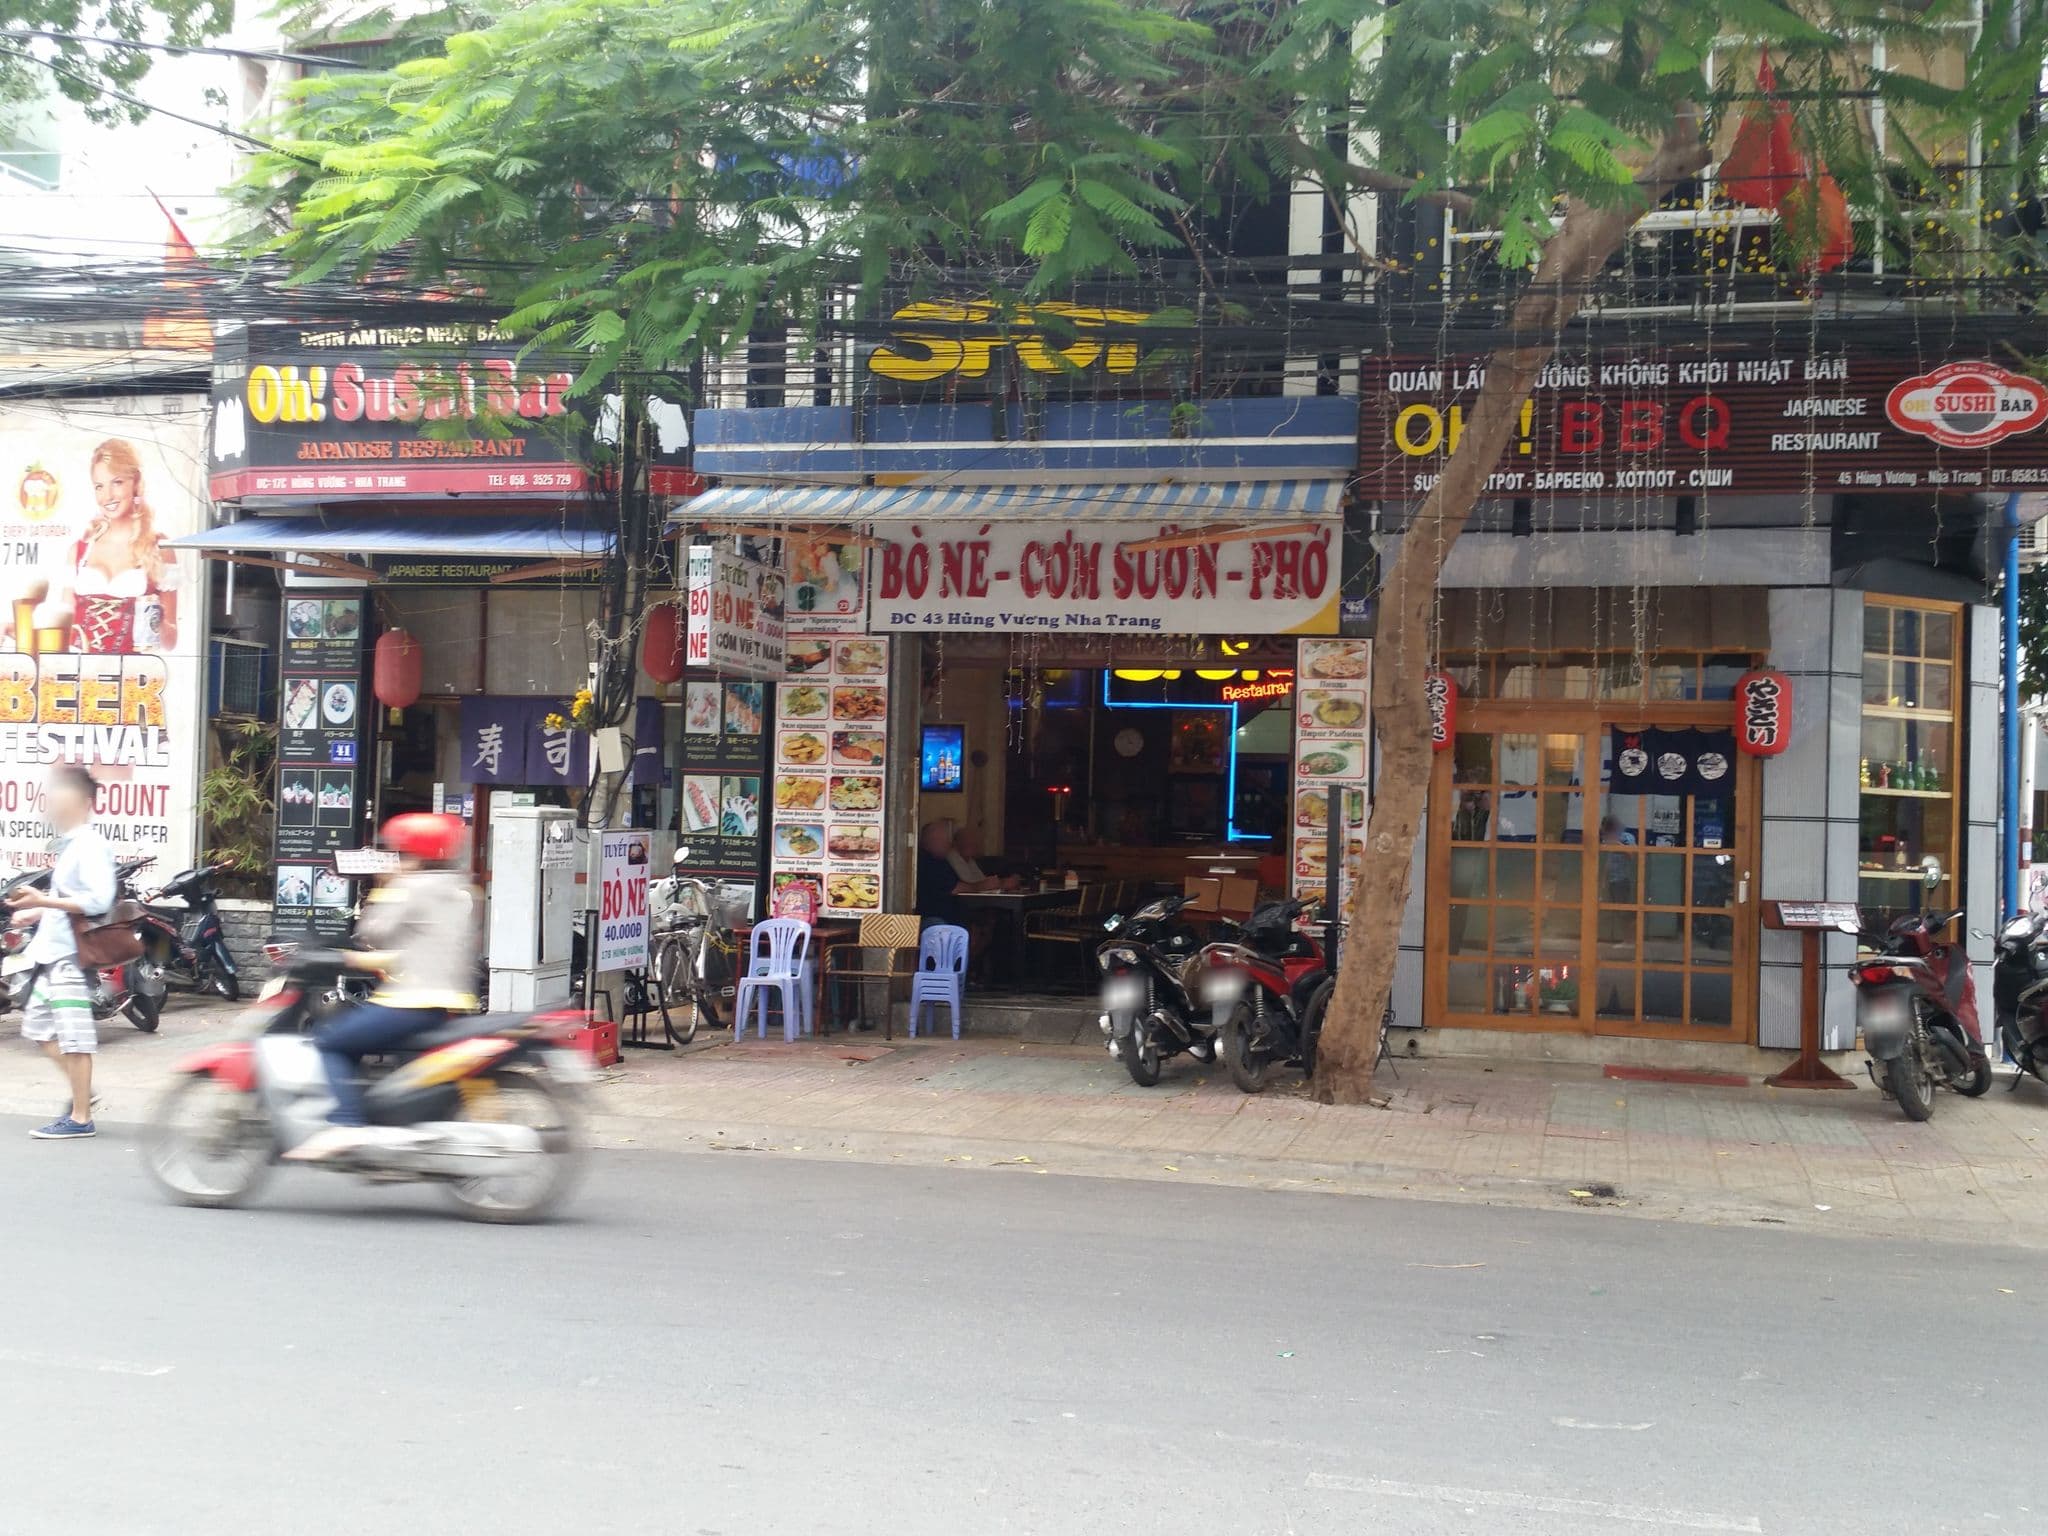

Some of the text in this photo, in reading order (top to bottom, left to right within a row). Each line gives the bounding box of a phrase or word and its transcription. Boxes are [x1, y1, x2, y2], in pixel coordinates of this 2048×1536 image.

[1388, 366, 1442, 392] QUÁN
[1600, 359, 1669, 390] KHÔNG
[1737, 357, 1794, 385] NHẬT
[247, 364, 327, 423] Oh!
[1934, 395, 1996, 412] SUSHI
[2001, 399, 2033, 412] BAR
[1783, 398, 1867, 417] JAPANESE
[297, 440, 392, 459] JAPANESE
[1771, 431, 1881, 451] RESTAURANT
[1689, 469, 1732, 487] СУШИ
[1952, 470, 1981, 486] Trang
[15, 543, 39, 565] PM
[880, 525, 930, 600] BÒ
[387, 564, 440, 577] JAPANESE
[690, 581, 709, 616] BÒ
[890, 612, 917, 624] ĐC
[922, 612, 943, 625] 43
[999, 613, 1060, 629] Vương
[1065, 614, 1101, 625] Nha
[1106, 614, 1161, 630] Trang
[689, 624, 709, 659] NÉ
[0, 652, 168, 726] BEER
[1746, 677, 1780, 746] やきとり
[0, 723, 169, 767] FESTIVAL
[604, 839, 627, 858] TUYẾT
[601, 866, 647, 921] BÒ NÉ
